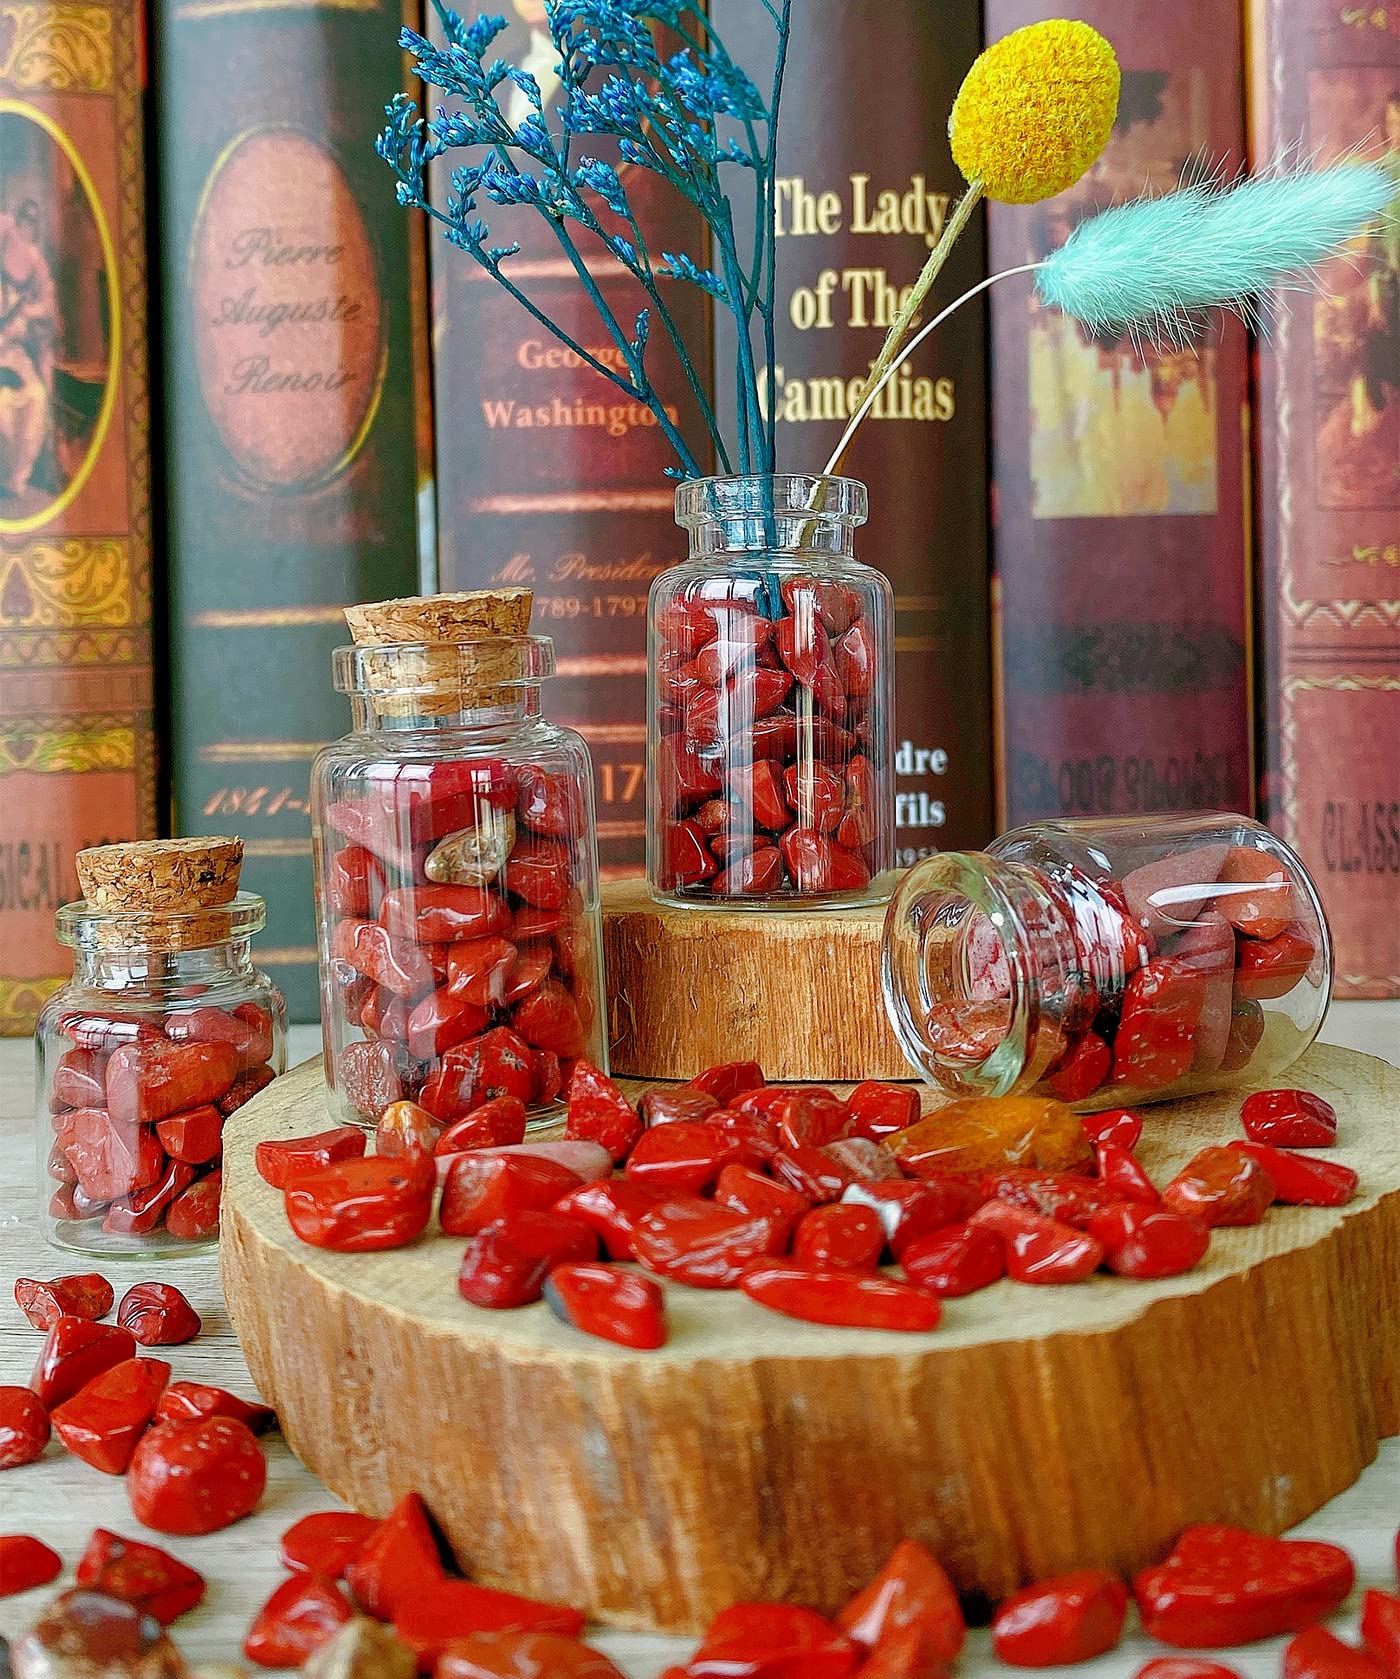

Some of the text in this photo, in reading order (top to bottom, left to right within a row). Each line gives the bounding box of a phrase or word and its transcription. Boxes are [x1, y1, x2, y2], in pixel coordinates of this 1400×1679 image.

[764, 173, 949, 249] The Lady
[224, 227, 344, 270] Pierre
[212, 287, 361, 337] Auguste
[789, 268, 838, 330] of
[224, 354, 358, 395] Renoir
[482, 399, 681, 436] Washington
[548, 551, 682, 582] Presiden
